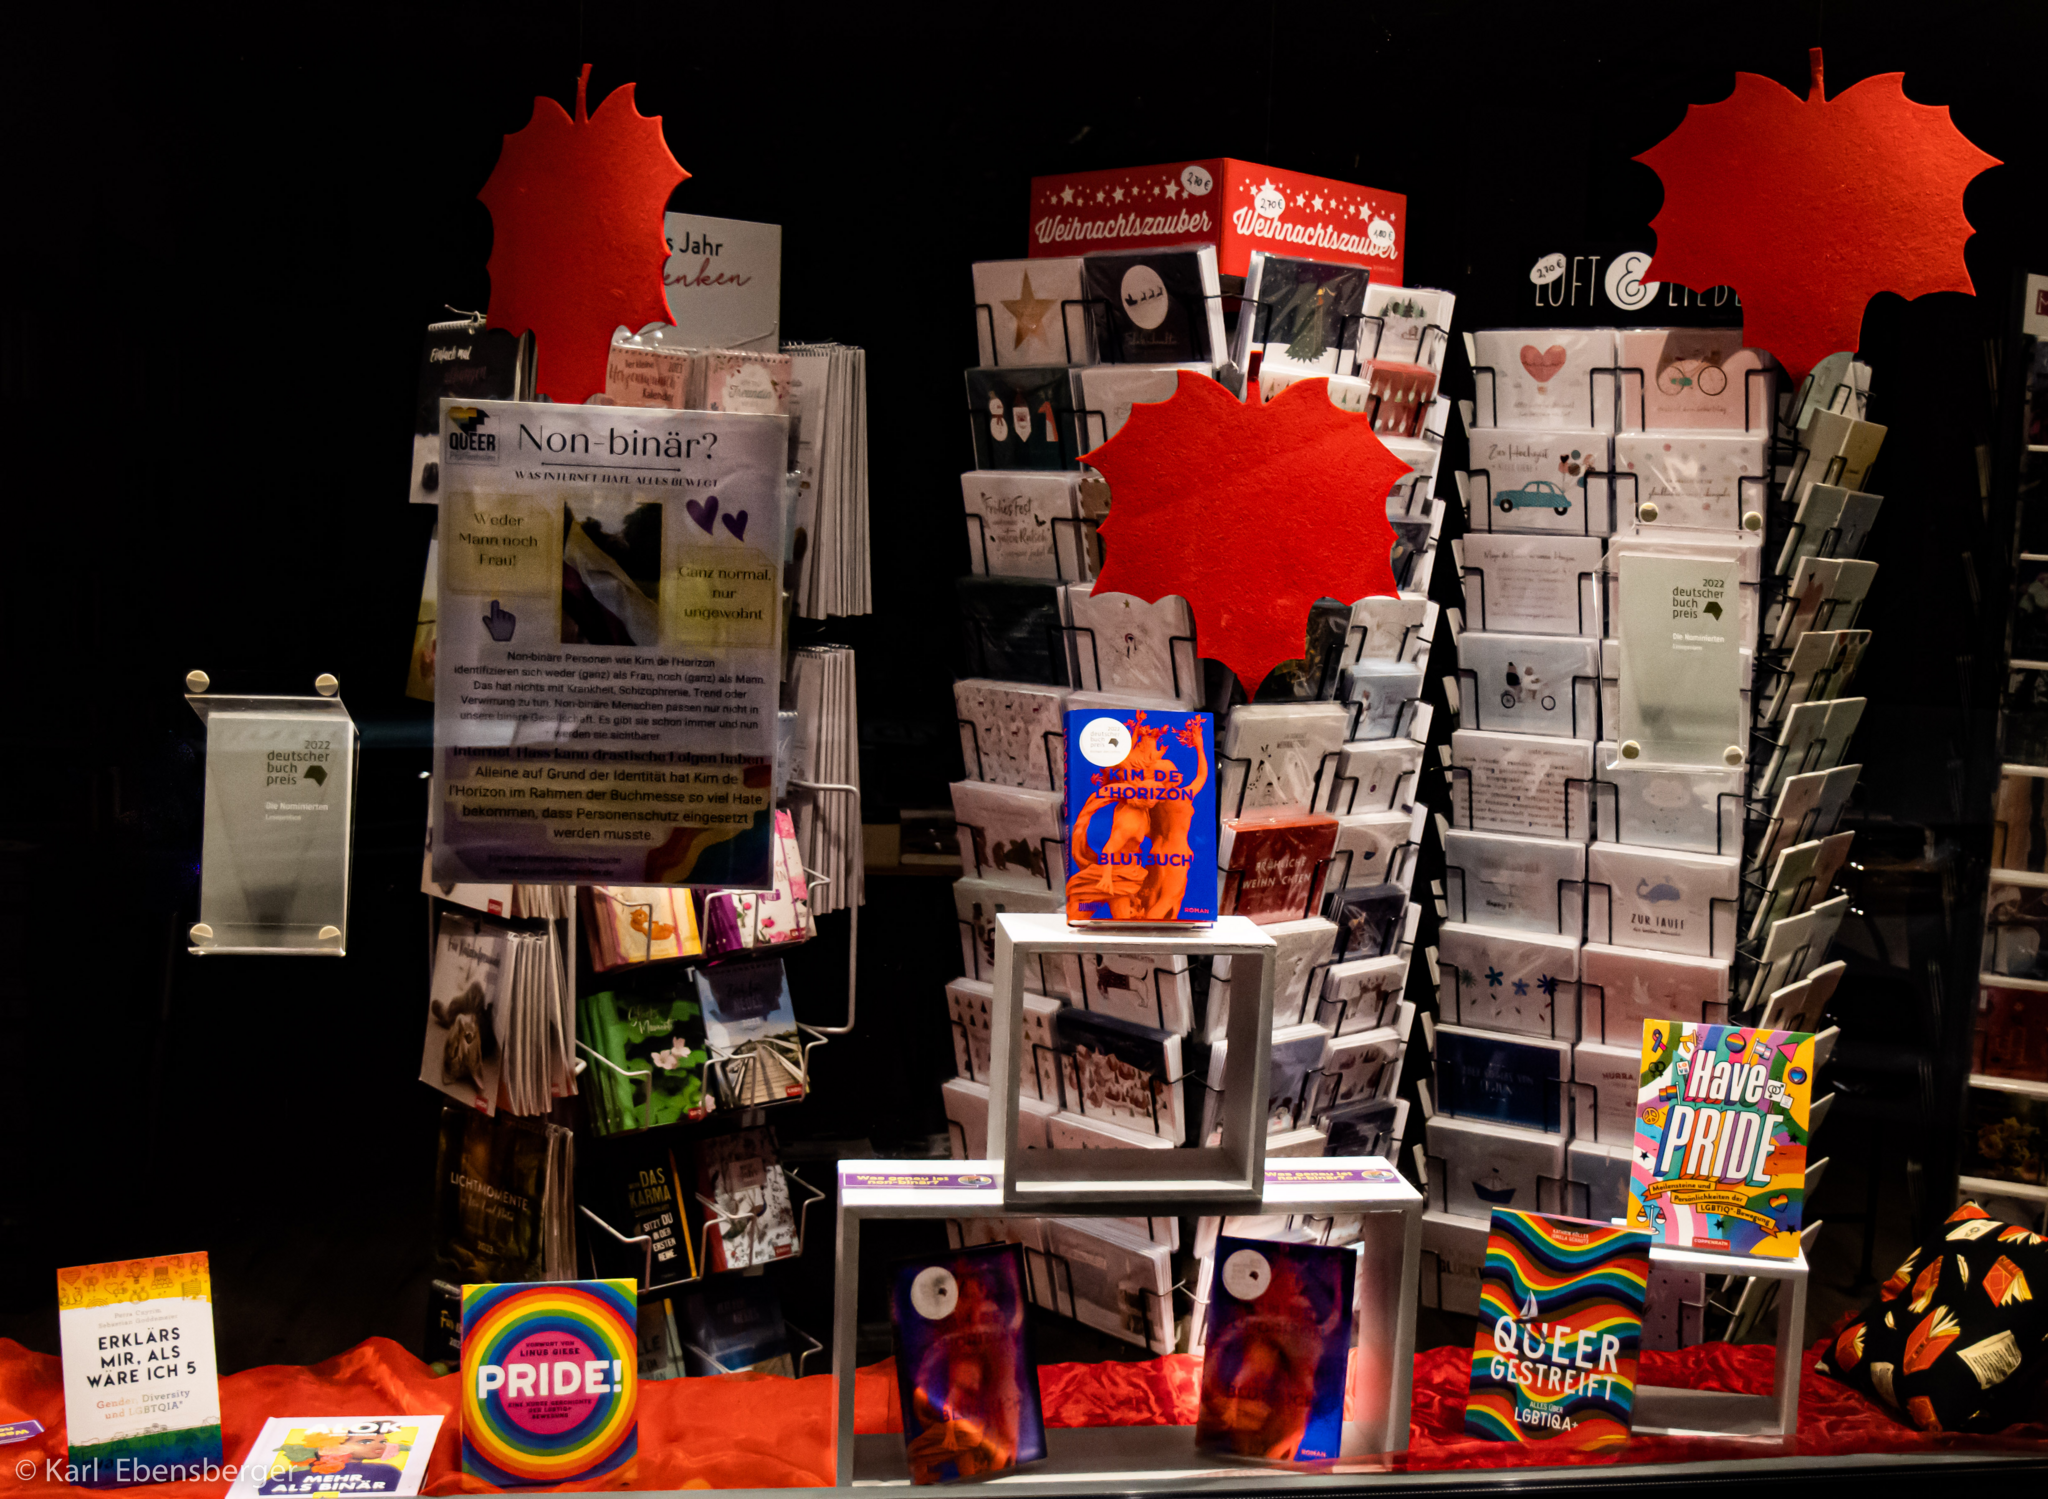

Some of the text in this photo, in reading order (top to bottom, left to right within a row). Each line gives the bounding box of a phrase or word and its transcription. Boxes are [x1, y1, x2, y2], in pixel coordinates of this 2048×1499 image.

[1035, 208, 1212, 245] Weihnachtszauber
[1233, 206, 1398, 261] Weihnachtszauber
[679, 231, 723, 256] Jahr
[1536, 264, 1555, 278] 2,70
[450, 432, 496, 451] QUEER
[518, 423, 719, 461] Non-binär?
[515, 470, 541, 479] WAS
[544, 472, 597, 483] INTERNET
[636, 475, 668, 486] ALLES
[474, 513, 524, 527] Weder
[460, 532, 538, 547] Mann noch
[479, 553, 517, 567] Frau!
[679, 566, 714, 580] Ganz
[1702, 578, 1725, 588] 2022
[712, 588, 737, 599] nur
[1672, 586, 1724, 599] deutscher
[1672, 597, 1698, 609] buch
[684, 606, 763, 622] ungewohnt
[1672, 608, 1698, 619] preis
[507, 651, 562, 662] Non-binäre
[565, 654, 612, 664] Personen
[615, 656, 632, 665] wie
[634, 656, 655, 665] Kim
[454, 664, 732, 684] identifizieren sich weder (ganz) als noch (ganz) als
[473, 681, 747, 699] Das hat nichts mit Trend oder
[555, 698, 608, 709] Non-binäre
[611, 700, 663, 711] Menschen
[666, 703, 701, 713] passen
[704, 704, 720, 713] nur
[723, 704, 747, 714] nicht
[613, 716, 758, 729] gibt sie schon immer und nun
[610, 731, 660, 741] sichtbarer
[304, 740, 331, 750] 2022
[267, 750, 330, 762] deutscher
[554, 748, 589, 760] kann
[592, 748, 668, 762] drastische
[720, 753, 763, 766] haben
[267, 762, 298, 774] buch
[475, 766, 738, 784] Alleine auf Grund der Identität hat Kim de
[1109, 768, 1180, 782] KIM DE
[266, 774, 297, 786] preis
[449, 785, 763, 805] l'Horizon im Rahmen der Buchmesse so viel Hate
[1096, 786, 1193, 801] L'HORIZON
[462, 805, 749, 825] bekommen, dass Personenschutz eingesetzt
[553, 828, 600, 840] werden
[1097, 852, 1193, 867] BLUTBUCH
[1242, 872, 1311, 890] WEIHNCHTEN
[1184, 906, 1209, 914] ROMAN
[1631, 912, 1651, 925] ZUR
[1685, 1049, 1767, 1107] Have
[1653, 1105, 1784, 1188] PRIDE
[639, 1167, 665, 1188] DAS
[451, 1171, 529, 1211] LICHTMOMENTE
[1653, 1183, 1696, 1192] Meilensteine
[628, 1184, 672, 1208] KARMA
[1674, 1194, 1743, 1202] Persönlichkeiten der
[660, 1212, 674, 1226] DU
[652, 1237, 677, 1253] ERSTEN
[114, 1311, 133, 1319] Petra
[98, 1320, 133, 1329] Sebastian
[98, 1327, 181, 1351] ERKLÄRS
[1493, 1315, 1620, 1374] QUEER
[101, 1345, 181, 1369] MIR, ALS
[520, 1347, 580, 1357] LINUS GIESE
[87, 1361, 197, 1388] WÄRE ICH 5
[478, 1360, 622, 1399] PRIDE!
[1490, 1355, 1617, 1401] GESTREIFT
[142, 1389, 190, 1403] Diversity
[1529, 1401, 1547, 1411] ALLES
[105, 1409, 125, 1420] und
[1514, 1406, 1579, 1431] LGBTIQA+
[304, 1422, 402, 1435] ALOK
[303, 1474, 363, 1483] MEHR
[271, 1480, 386, 1493] ALS BINÄR
